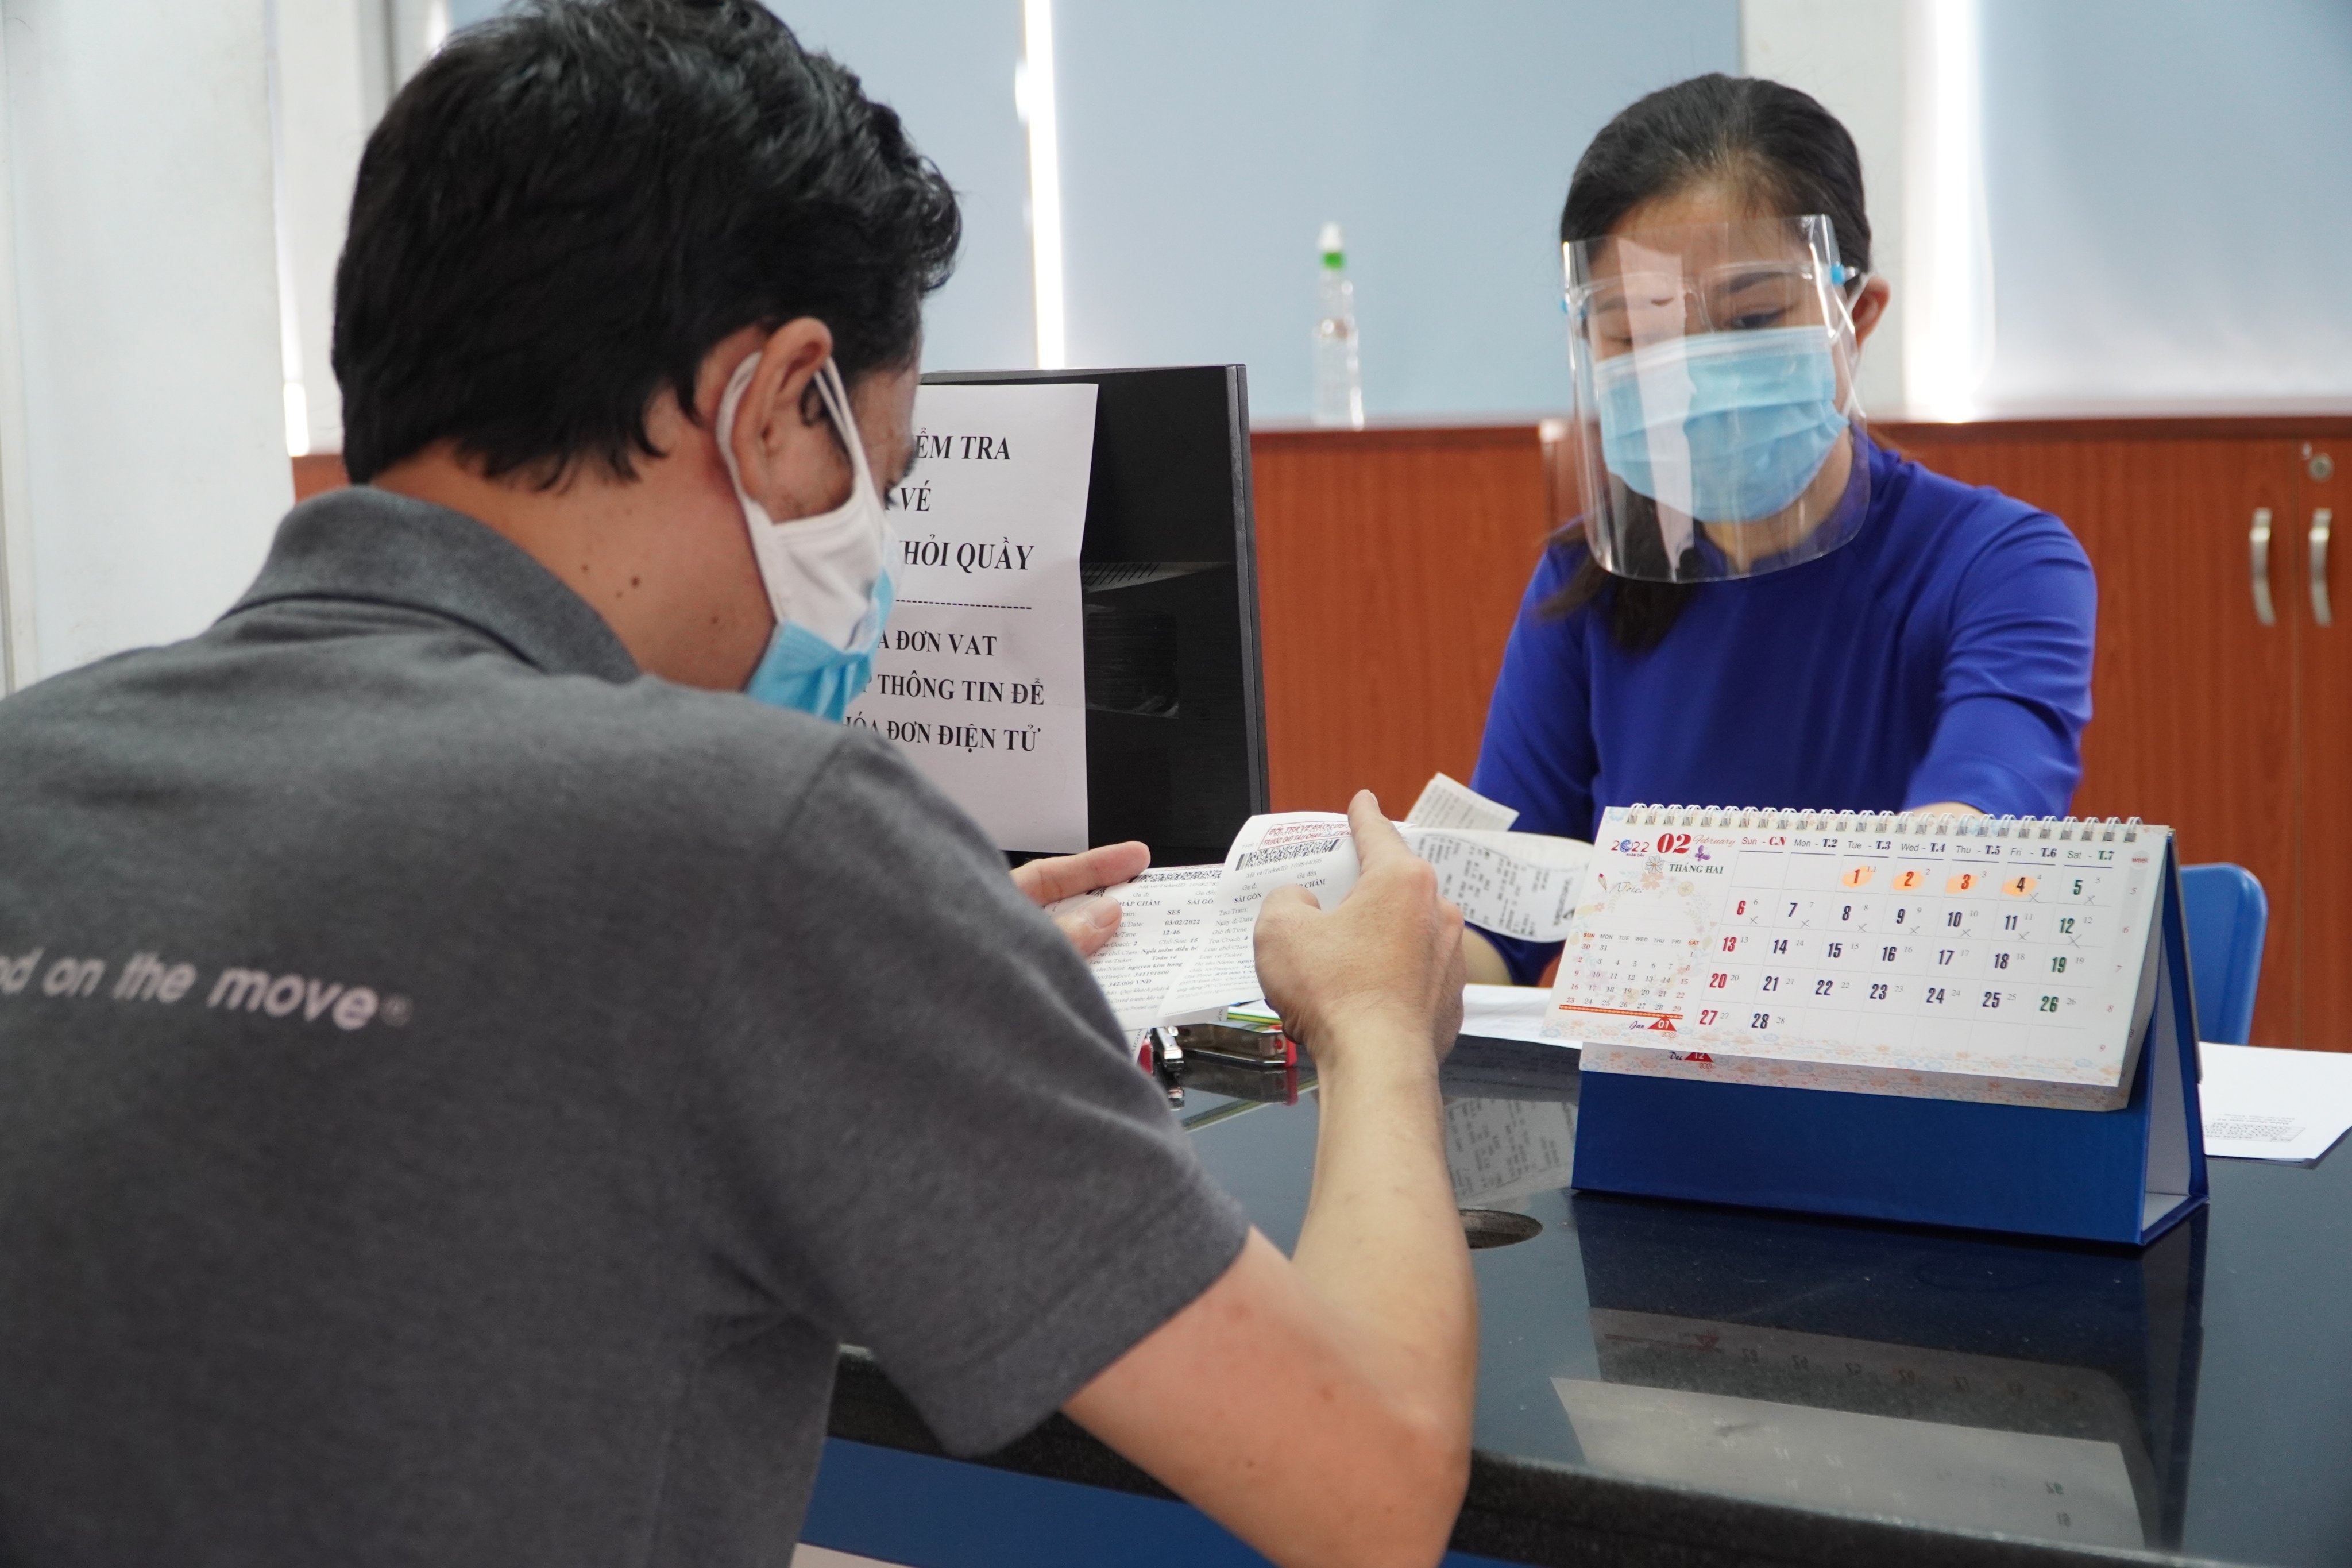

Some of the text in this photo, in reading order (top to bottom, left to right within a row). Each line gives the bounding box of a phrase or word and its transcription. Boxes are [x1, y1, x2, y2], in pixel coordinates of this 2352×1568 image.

[961, 436, 1011, 459] TRA
[901, 480, 931, 511] VÉ
[899, 534, 1034, 573] HỎI QUẦY
[896, 630, 941, 652] ĐƠN
[948, 634, 997, 656] VAT
[878, 670, 955, 700] THÔNG
[962, 681, 1005, 702] TIN
[1011, 678, 1045, 705] ĐỂ
[887, 721, 931, 743] ĐƠN
[938, 724, 996, 753] ĐIỆN
[1004, 724, 1041, 751] TỬ
[1657, 833, 1737, 854] 02 February
[1741, 836, 1786, 846] Sun C.N
[1794, 838, 1837, 848] Mon T.2
[1848, 840, 1891, 851] Tue T.3
[1901, 843, 1945, 853] Wed T.4
[1956, 845, 2001, 855] Thu T.5
[2010, 848, 2057, 858] Fri T.6
[2068, 850, 2115, 861] Sat T.7
[1670, 863, 1724, 874] THÁNG HAI
[1304, 879, 1326, 889] CHÀM
[1853, 868, 2083, 895] 1 2 3 4 5
[1737, 900, 2075, 934] 6 7 8 9 10 11 12
[1722, 937, 2068, 973] 13 14 15 16 17 18 19
[43, 957, 106, 997] on
[112, 951, 197, 1003] the
[1709, 973, 2059, 1013] 20 21 22 23 24 25 26
[1629, 1019, 1670, 1030] Jan 01
[1699, 1010, 1770, 1029] 27 28
[1669, 1051, 1683, 1060] Dec
